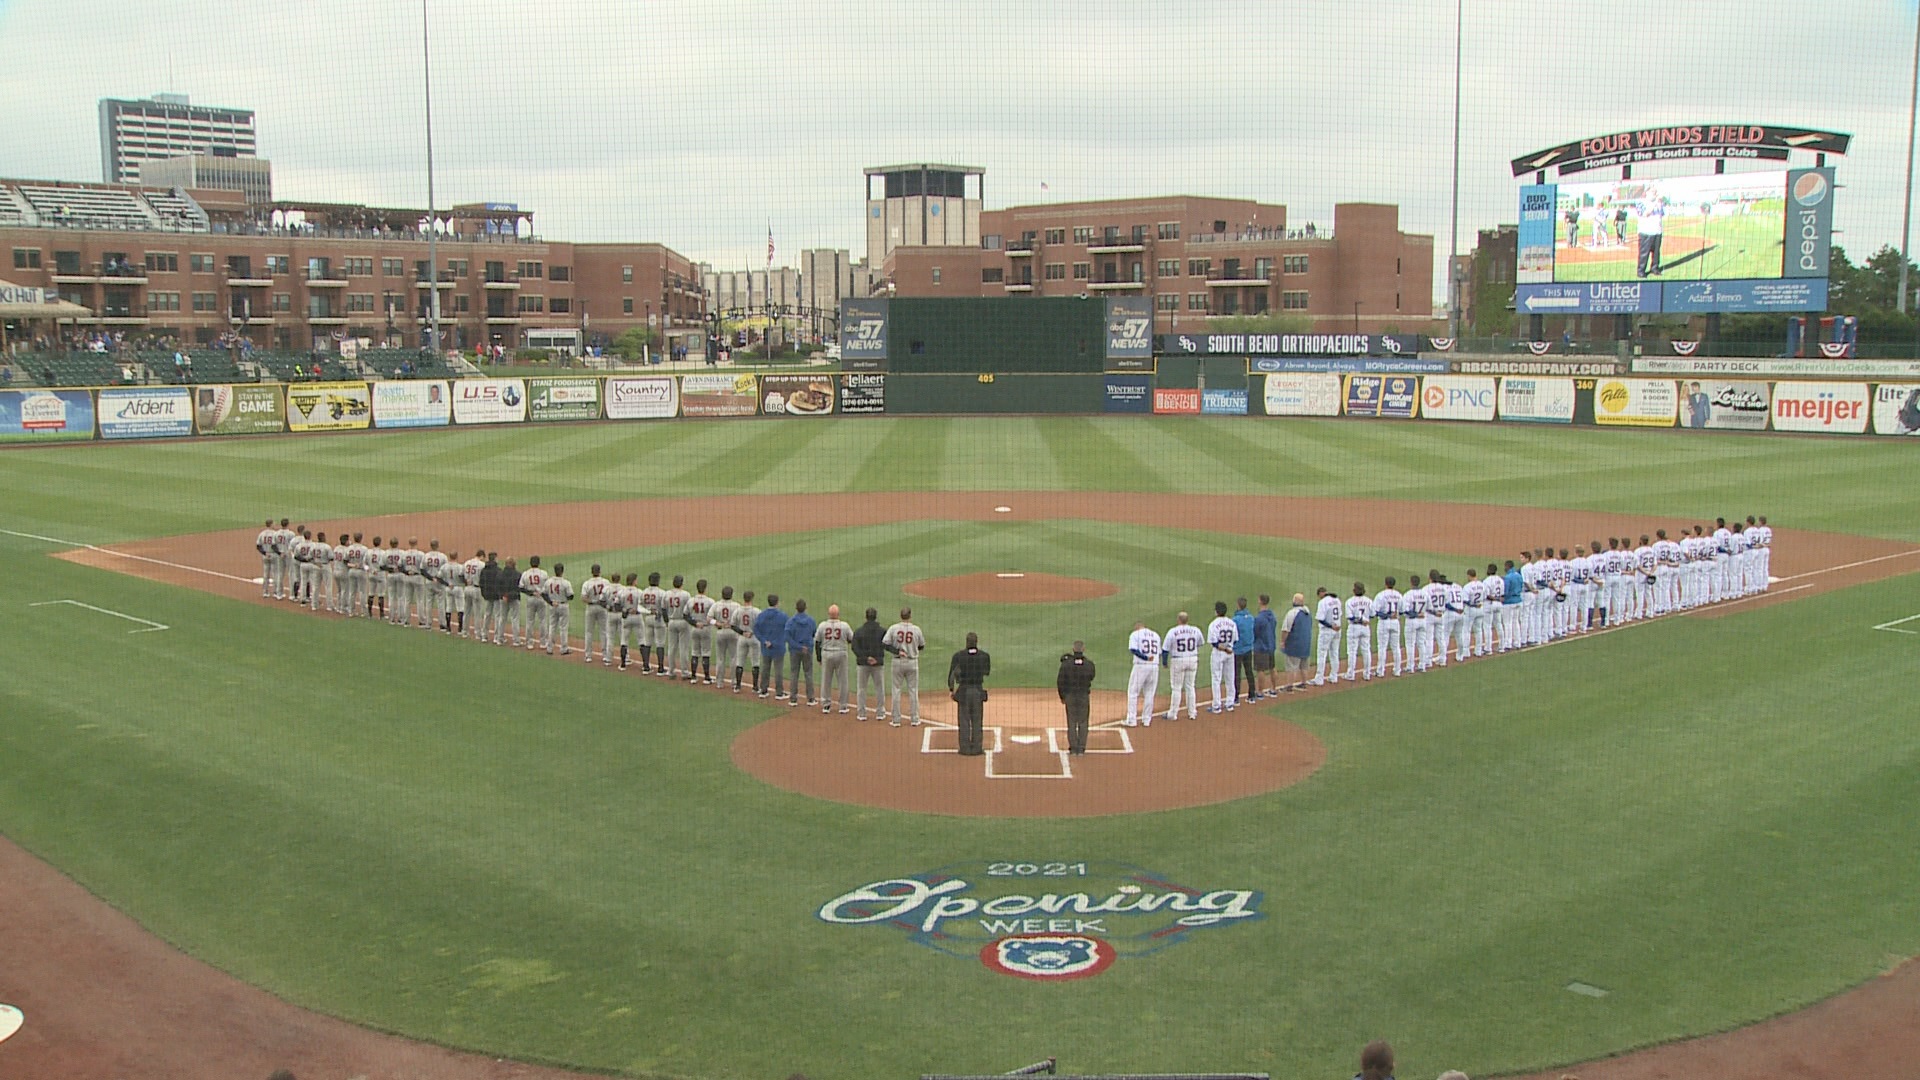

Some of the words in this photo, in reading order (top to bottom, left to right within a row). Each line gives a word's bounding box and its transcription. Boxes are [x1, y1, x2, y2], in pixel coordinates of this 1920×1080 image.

[1580, 133, 1631, 157] FOUR
[1636, 127, 1703, 148] WINDS
[1708, 126, 1764, 144] FIELD
[1584, 156, 1617, 170] Home
[1619, 152, 1632, 164] of
[1633, 151, 1653, 162] the
[1655, 148, 1690, 160] South
[1692, 147, 1723, 157] Bend
[1726, 147, 1759, 158] Cubs
[1526, 194, 1547, 203] BUD
[1522, 202, 1550, 212] LIGHT
[1799, 209, 1817, 271] pepsi
[1590, 283, 1640, 299] United
[1688, 294, 1714, 302] Adams
[1716, 293, 1742, 302] Remco
[844, 324, 859, 332] abc
[858, 320, 884, 340] 57
[1110, 322, 1124, 332] abc
[1122, 318, 1150, 338] 57
[846, 340, 883, 350] NEWS
[1110, 338, 1148, 350] NEWS
[1208, 335, 1245, 354] SOUTH
[1248, 335, 1279, 354] BEND
[1282, 335, 1368, 354] ORTHOPAEDICS
[1460, 362, 1614, 375] RBCARCOMPANY.COM
[1694, 362, 1728, 371] PARTY
[1730, 363, 1760, 372] DECK
[1770, 363, 1900, 374] www.RiverValleyDecks.com
[978, 374, 994, 383] 405
[1352, 378, 1380, 388] Ridge
[1506, 380, 1536, 388] INSPIRED
[1576, 380, 1594, 390] 360
[464, 386, 499, 399] U.S.
[614, 382, 668, 402] Kountry
[1601, 388, 1627, 404] Pella
[1711, 385, 1758, 404] Louie's
[1878, 388, 1904, 402] Lite
[1204, 397, 1246, 408] TRIBUNE
[1450, 389, 1492, 408] PNC
[124, 399, 175, 416] Afdent
[238, 401, 275, 412] GAME
[1164, 402, 1190, 410] BEND
[1777, 392, 1862, 424] meijer
[312, 549, 322, 558] 12
[372, 554, 378, 563] 2
[406, 556, 416, 566] 21
[426, 558, 440, 568] 29
[1643, 557, 1654, 568] 29
[449, 570, 453, 579] 1
[466, 564, 477, 574] 35
[1578, 568, 1588, 580] 19
[1594, 564, 1606, 576] 44
[529, 575, 540, 585] 19
[550, 583, 560, 594] 14
[592, 584, 604, 596] 17
[626, 594, 634, 604] 4
[644, 594, 656, 604] 22
[669, 597, 680, 608] 13
[1431, 595, 1445, 607] 20
[1450, 591, 1461, 602] 15
[1474, 592, 1481, 604] 2
[692, 602, 704, 614] 41
[1332, 608, 1339, 620] 9
[1388, 602, 1398, 614] 11
[1412, 602, 1426, 614] 17
[742, 615, 749, 626] 6
[824, 628, 842, 640] 23
[896, 631, 913, 644] 36
[1142, 640, 1158, 654] 35
[1176, 638, 1196, 652] 50
[987, 862, 1087, 876] 2021
[818, 880, 1257, 931] Opening
[979, 918, 1108, 934] WEEK
